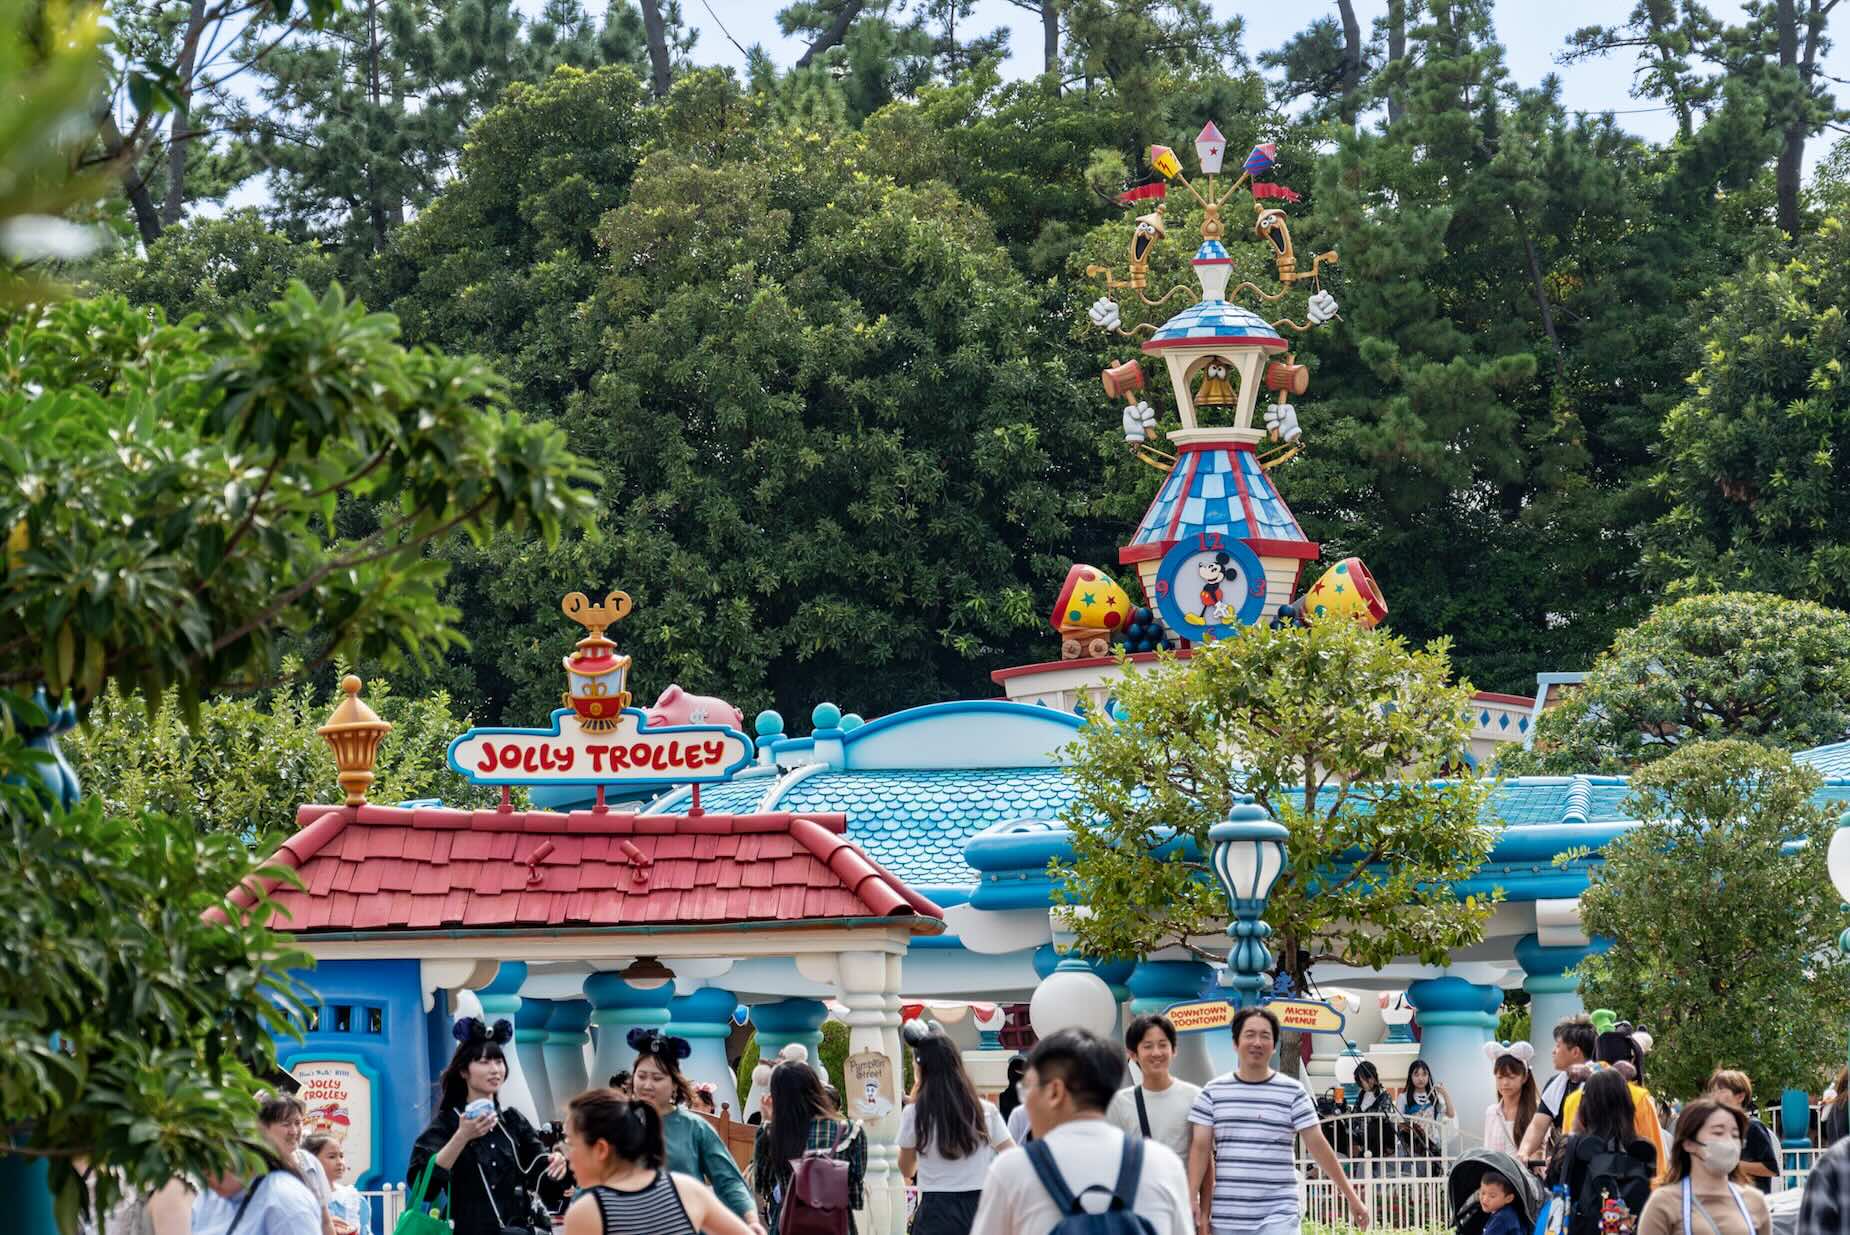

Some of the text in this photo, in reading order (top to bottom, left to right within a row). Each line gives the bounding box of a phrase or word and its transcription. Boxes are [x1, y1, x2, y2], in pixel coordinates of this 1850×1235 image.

[1198, 532, 1224, 550] 12
[1156, 580, 1169, 598] 9
[1252, 578, 1266, 596] 3
[569, 597, 624, 613] J T
[477, 740, 725, 773] JOLLY TROLLEY
[1170, 1006, 1227, 1018] DOWNTOWN
[1284, 1007, 1319, 1016] MICKEY
[1173, 1015, 1227, 1026] TOONTOWN
[1283, 1016, 1317, 1025] AVENUE
[308, 1079, 341, 1089] JOLLY
[304, 1089, 347, 1101] TROLLEY
